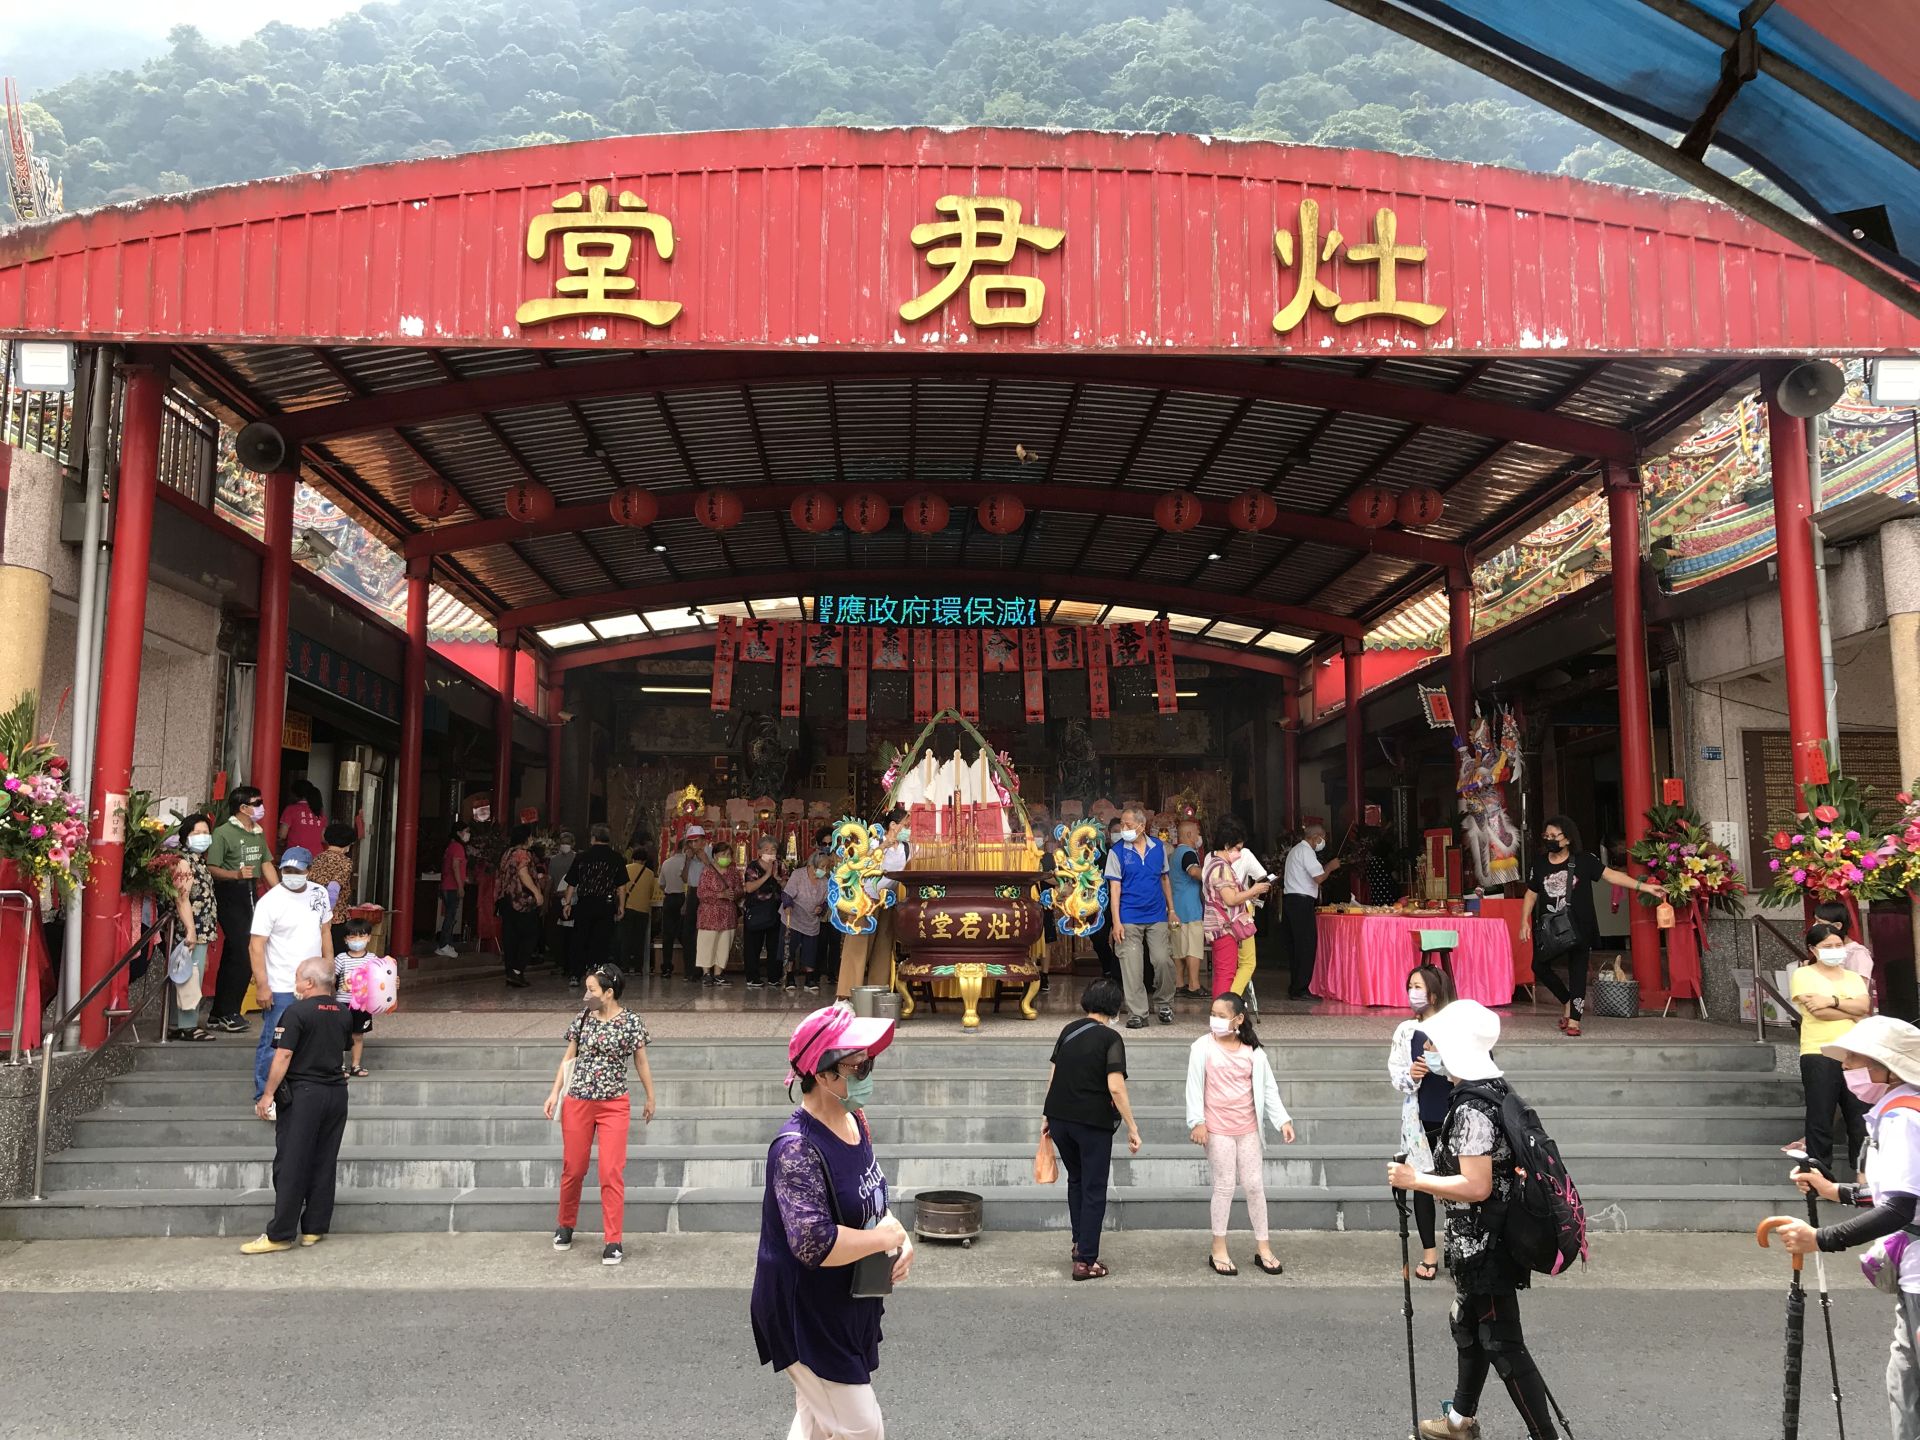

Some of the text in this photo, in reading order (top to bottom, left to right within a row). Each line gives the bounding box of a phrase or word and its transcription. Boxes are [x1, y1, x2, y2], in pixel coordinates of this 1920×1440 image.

[820, 594, 1036, 625] 應政府環保減
[930, 911, 1010, 940] 灶君堂
